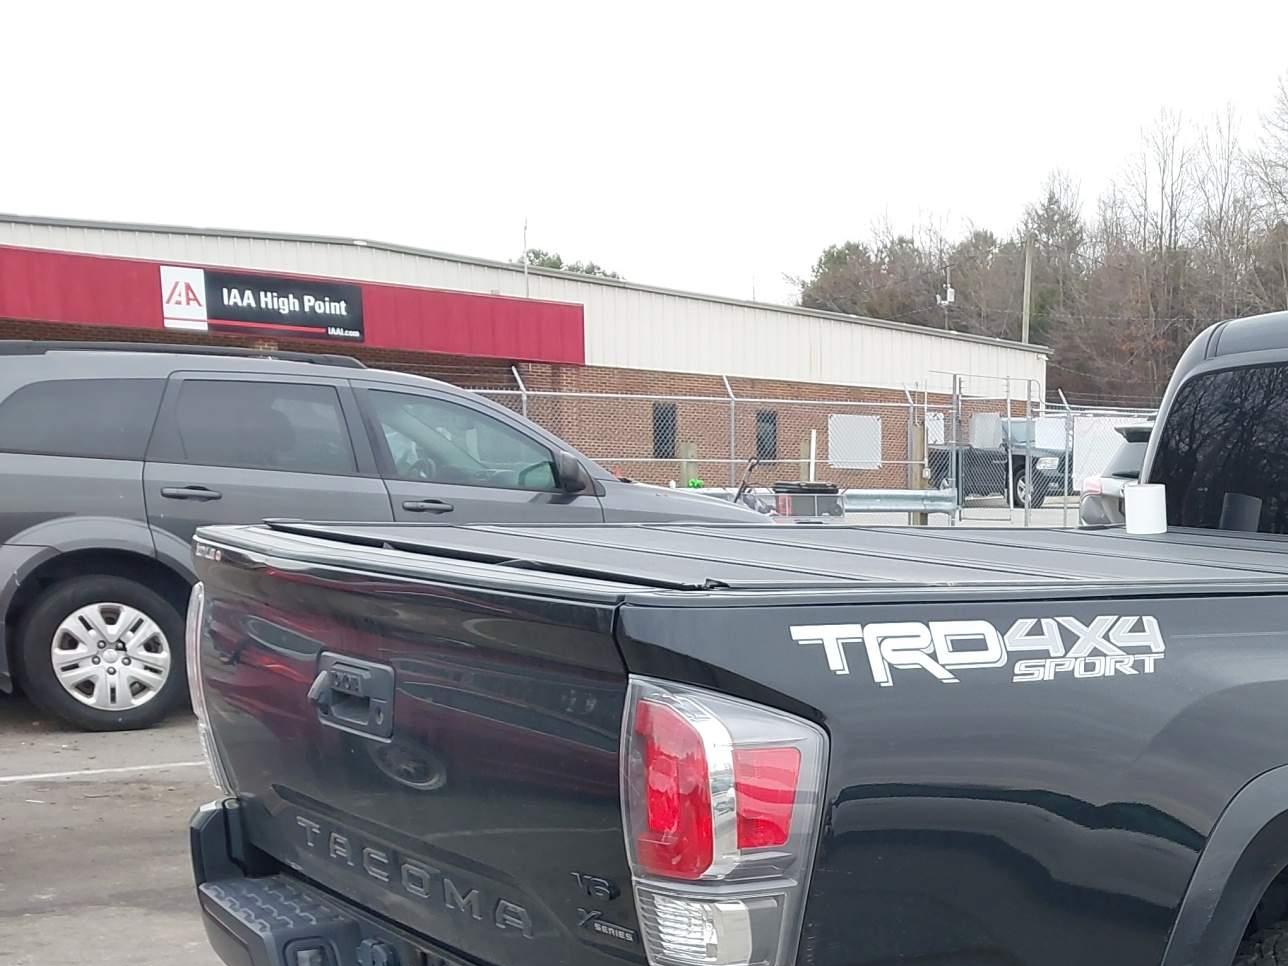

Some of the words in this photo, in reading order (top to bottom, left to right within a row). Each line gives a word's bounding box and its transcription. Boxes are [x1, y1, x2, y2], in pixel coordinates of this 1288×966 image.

[222, 287, 256, 308] IAA
[259, 291, 299, 314] High
[303, 295, 347, 316] Point
[789, 620, 1008, 687] TRD
[1012, 653, 1165, 683] SPORT
[296, 815, 535, 939] TACOMA
[593, 922, 635, 942] SERIES
